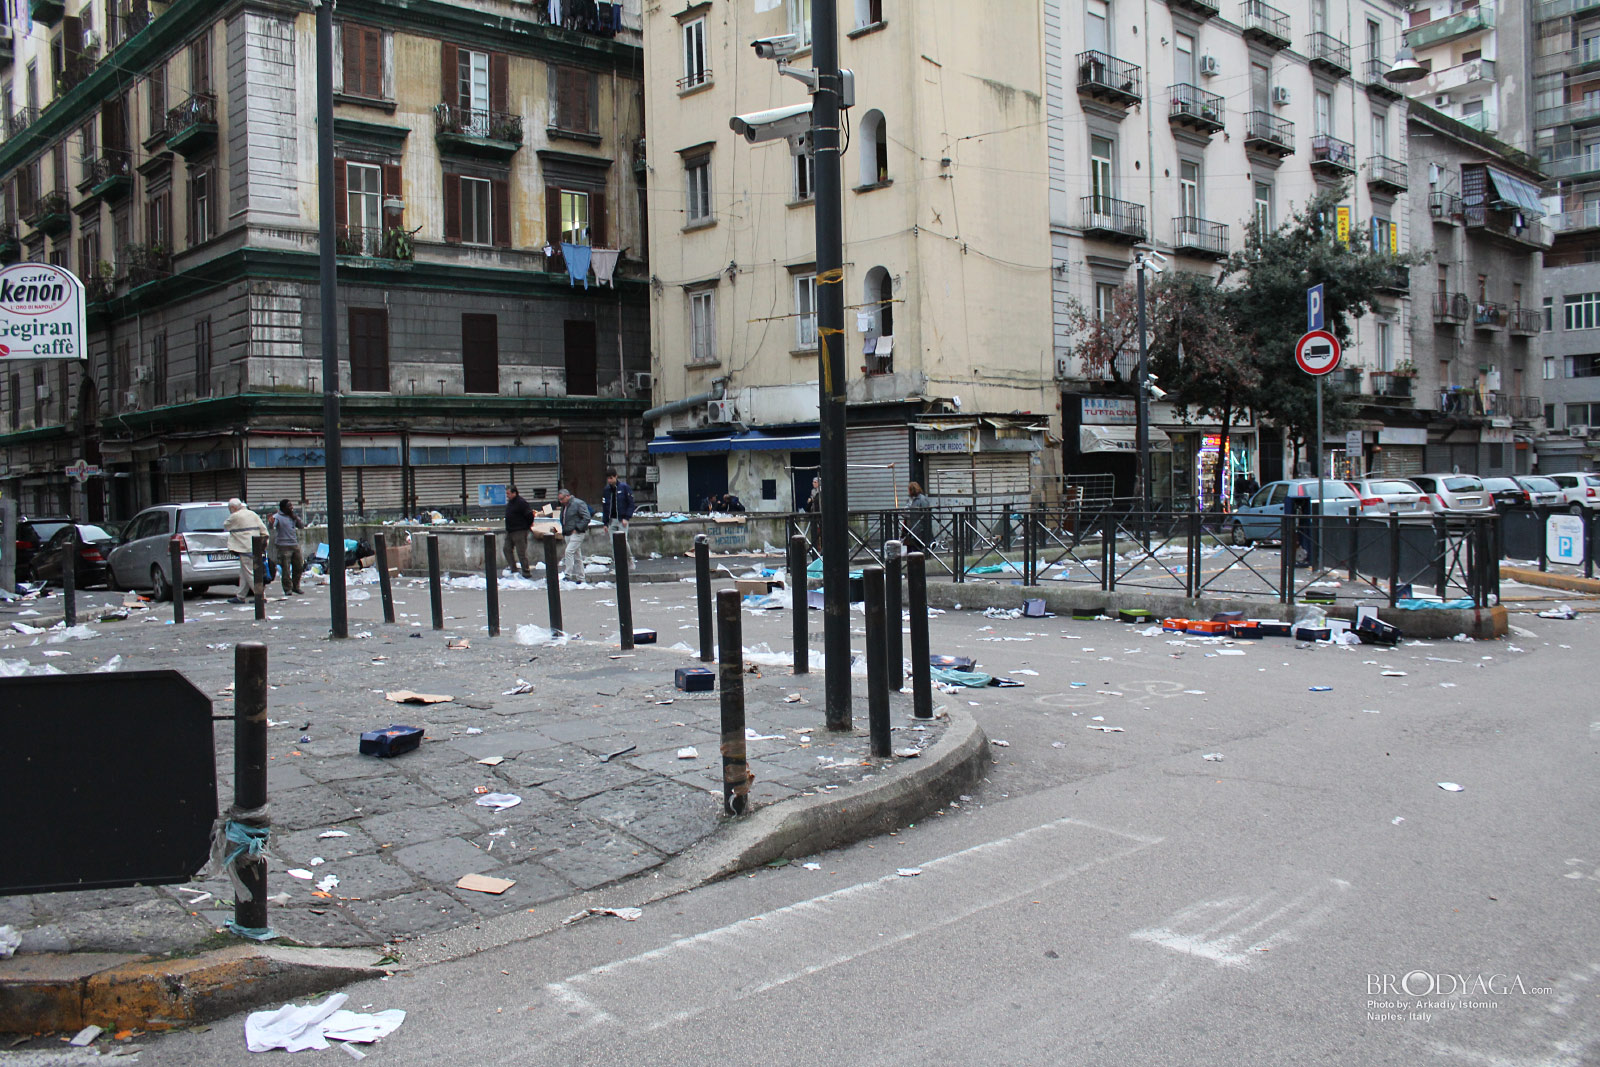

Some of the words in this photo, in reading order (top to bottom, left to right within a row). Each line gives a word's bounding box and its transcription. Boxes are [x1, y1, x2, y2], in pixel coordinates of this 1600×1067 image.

[0, 278, 64, 302] kenon
[1311, 291, 1320, 327] P
[0, 318, 73, 342] Gegiran
[33, 338, 74, 355] caffè
[1560, 538, 1571, 556] P
